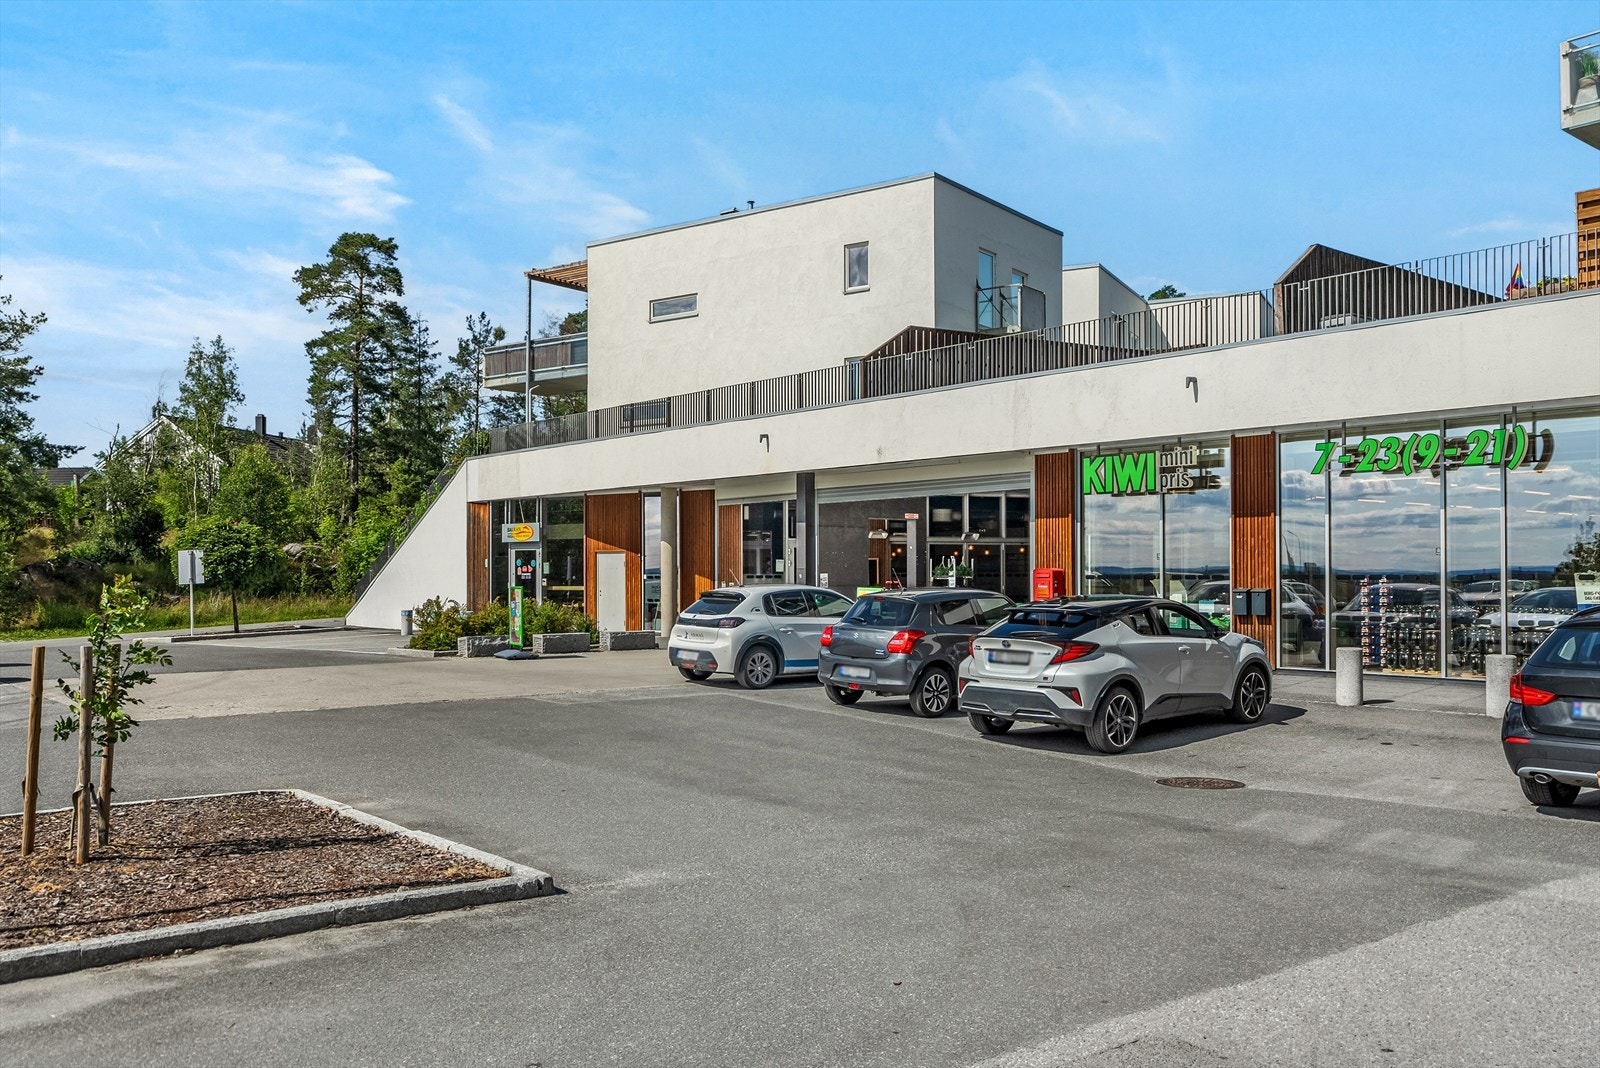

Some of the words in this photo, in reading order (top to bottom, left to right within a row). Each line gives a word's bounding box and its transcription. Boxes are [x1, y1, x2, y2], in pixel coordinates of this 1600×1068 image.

[1160, 446, 1197, 467] mini
[1083, 452, 1157, 495] KIWI
[1160, 467, 1192, 493] pris
